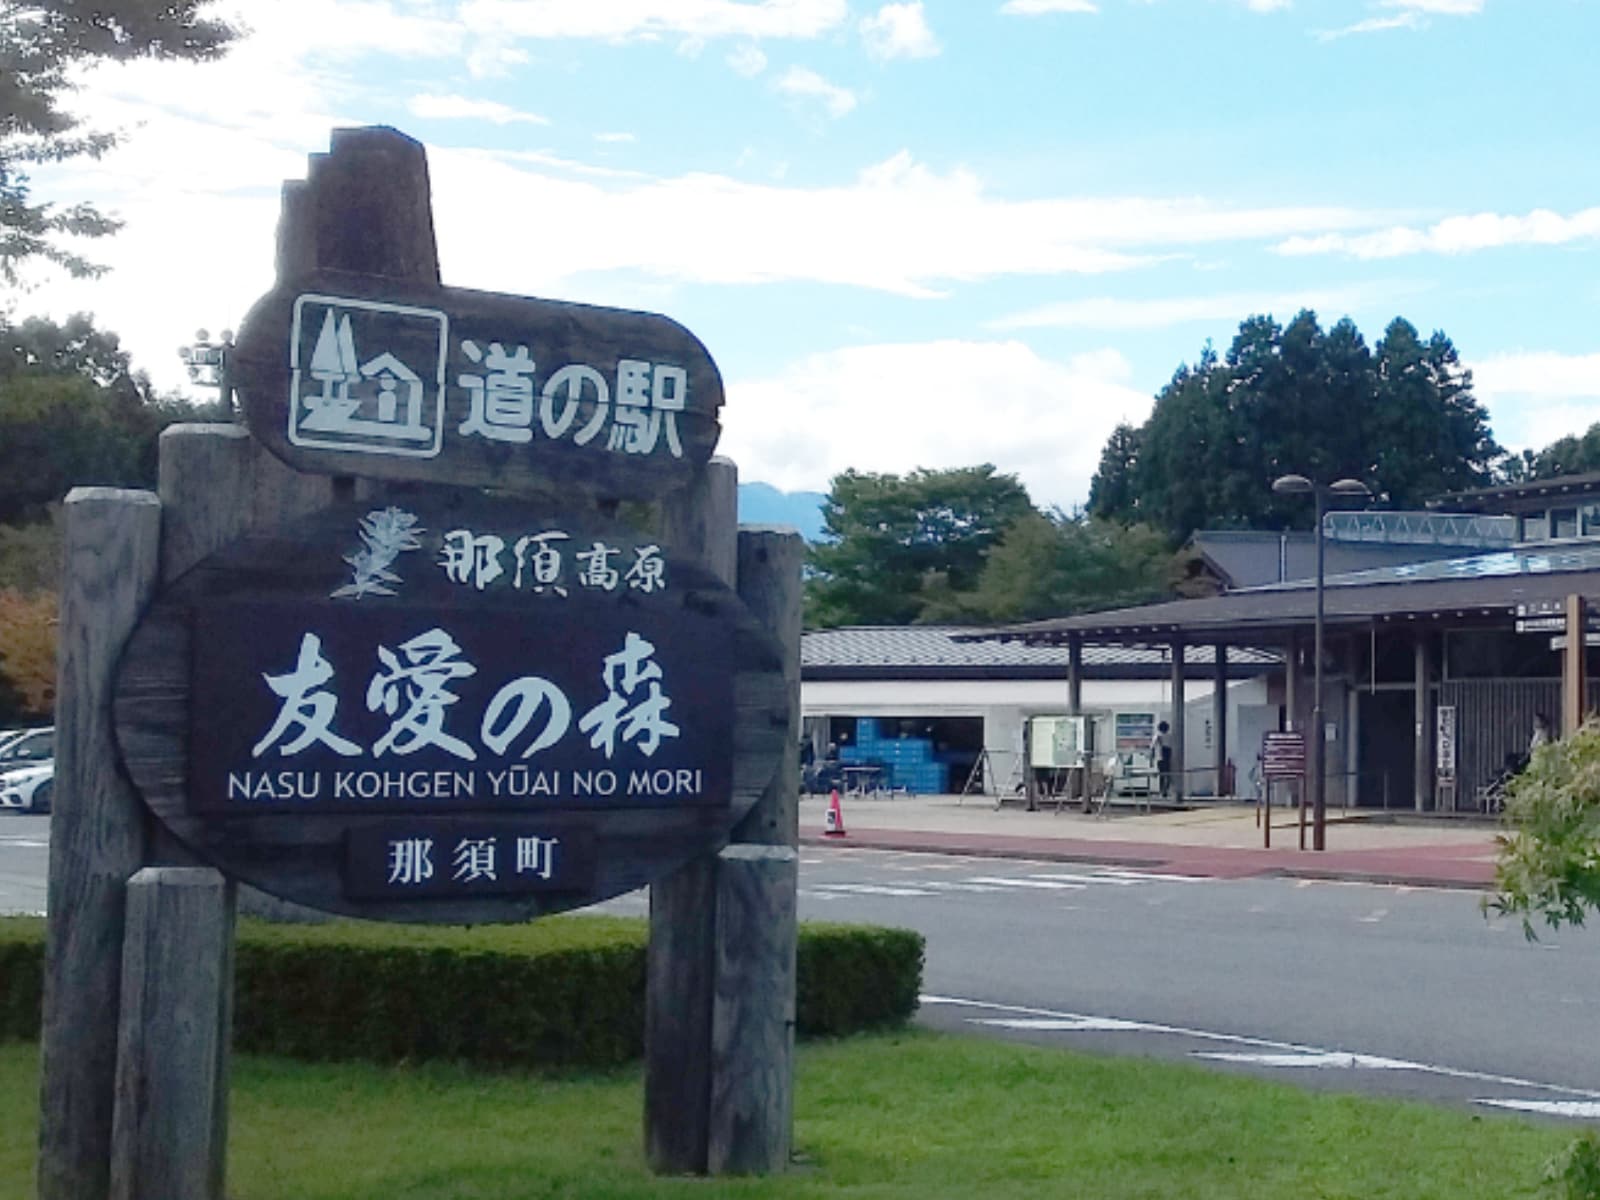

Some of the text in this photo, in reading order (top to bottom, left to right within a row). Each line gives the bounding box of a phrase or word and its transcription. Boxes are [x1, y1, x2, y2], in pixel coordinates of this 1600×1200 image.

[457, 339, 688, 458] 道の駅
[252, 628, 681, 761] 友愛の森
[227, 771, 320, 799] NASU
[333, 771, 476, 798] KOHGEN
[572, 771, 618, 796] NO
[626, 769, 703, 795] MORI
[387, 836, 561, 884] 那須町
